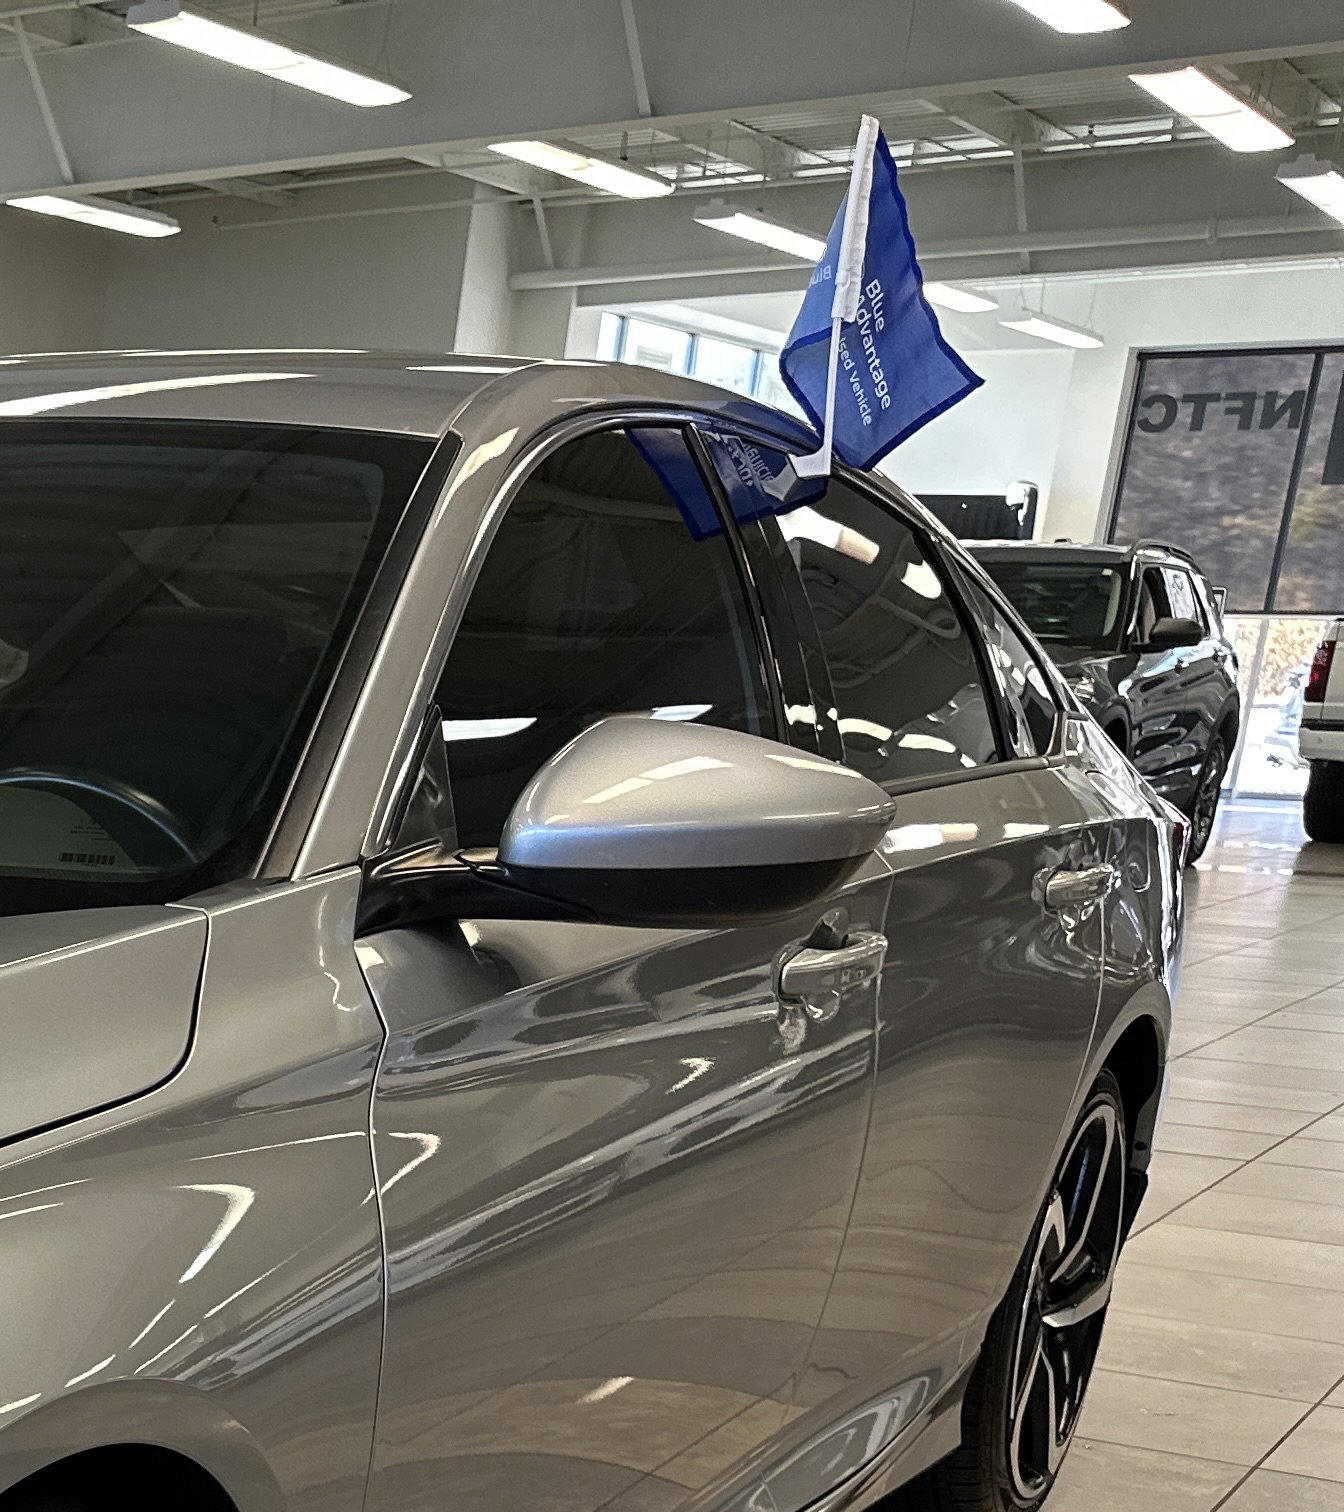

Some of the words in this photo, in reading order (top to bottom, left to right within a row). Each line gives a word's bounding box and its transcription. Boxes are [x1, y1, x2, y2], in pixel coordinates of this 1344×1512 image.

[865, 278, 885, 333] Blue
[837, 337, 855, 371] sed
[849, 370, 872, 427] Vehicle
